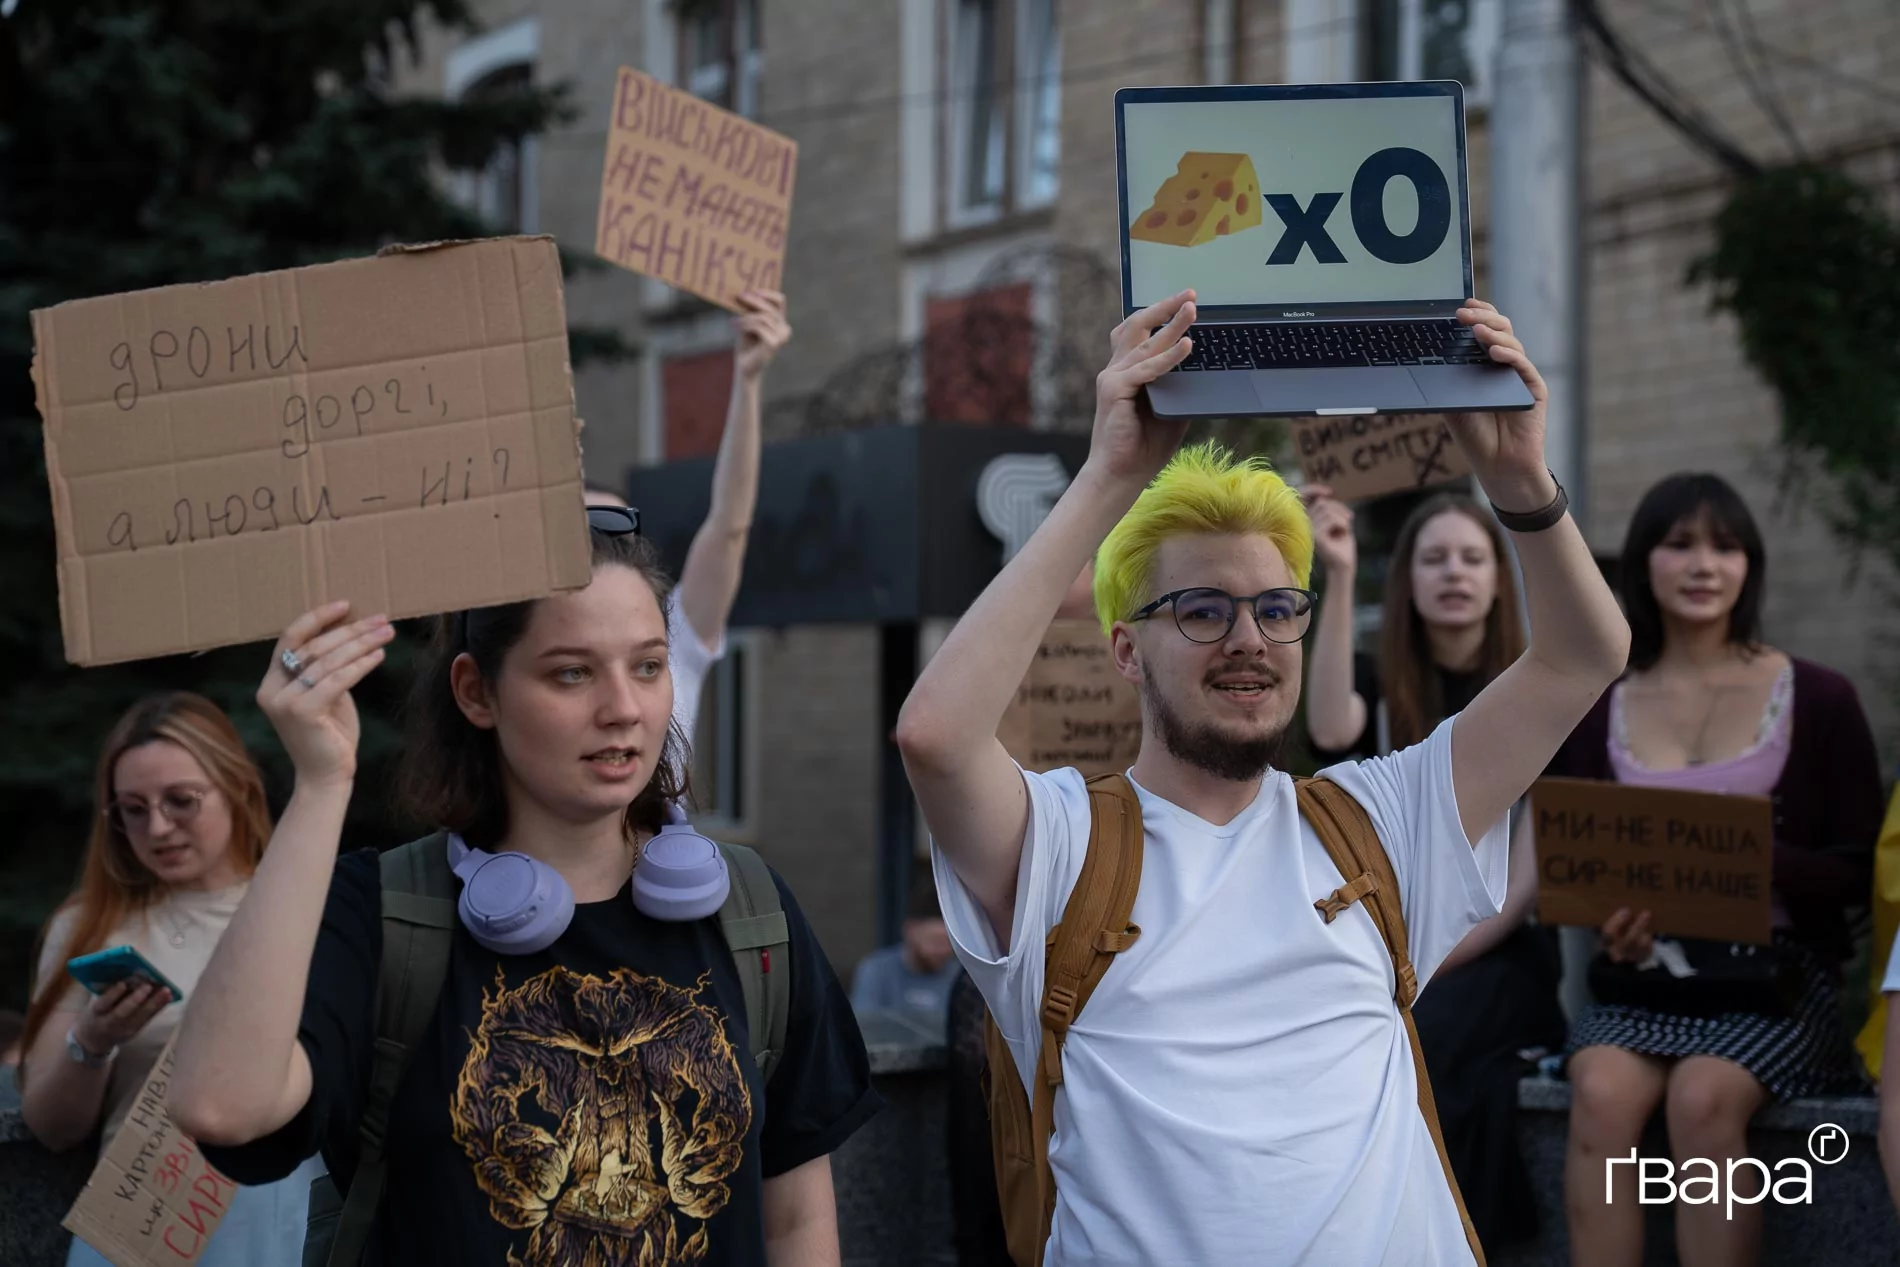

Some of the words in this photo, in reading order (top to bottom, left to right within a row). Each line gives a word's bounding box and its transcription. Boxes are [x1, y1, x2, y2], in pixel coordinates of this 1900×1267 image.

[607, 144, 664, 202] НЕ
[664, 164, 784, 250] МАЮТЬ
[110, 324, 308, 411] дрони
[107, 512, 137, 551] а
[166, 486, 342, 545] люди
[1665, 818, 1761, 855] РАША
[1673, 866, 1761, 899] НАШЕ
[153, 1132, 197, 1196] ЗВІ
